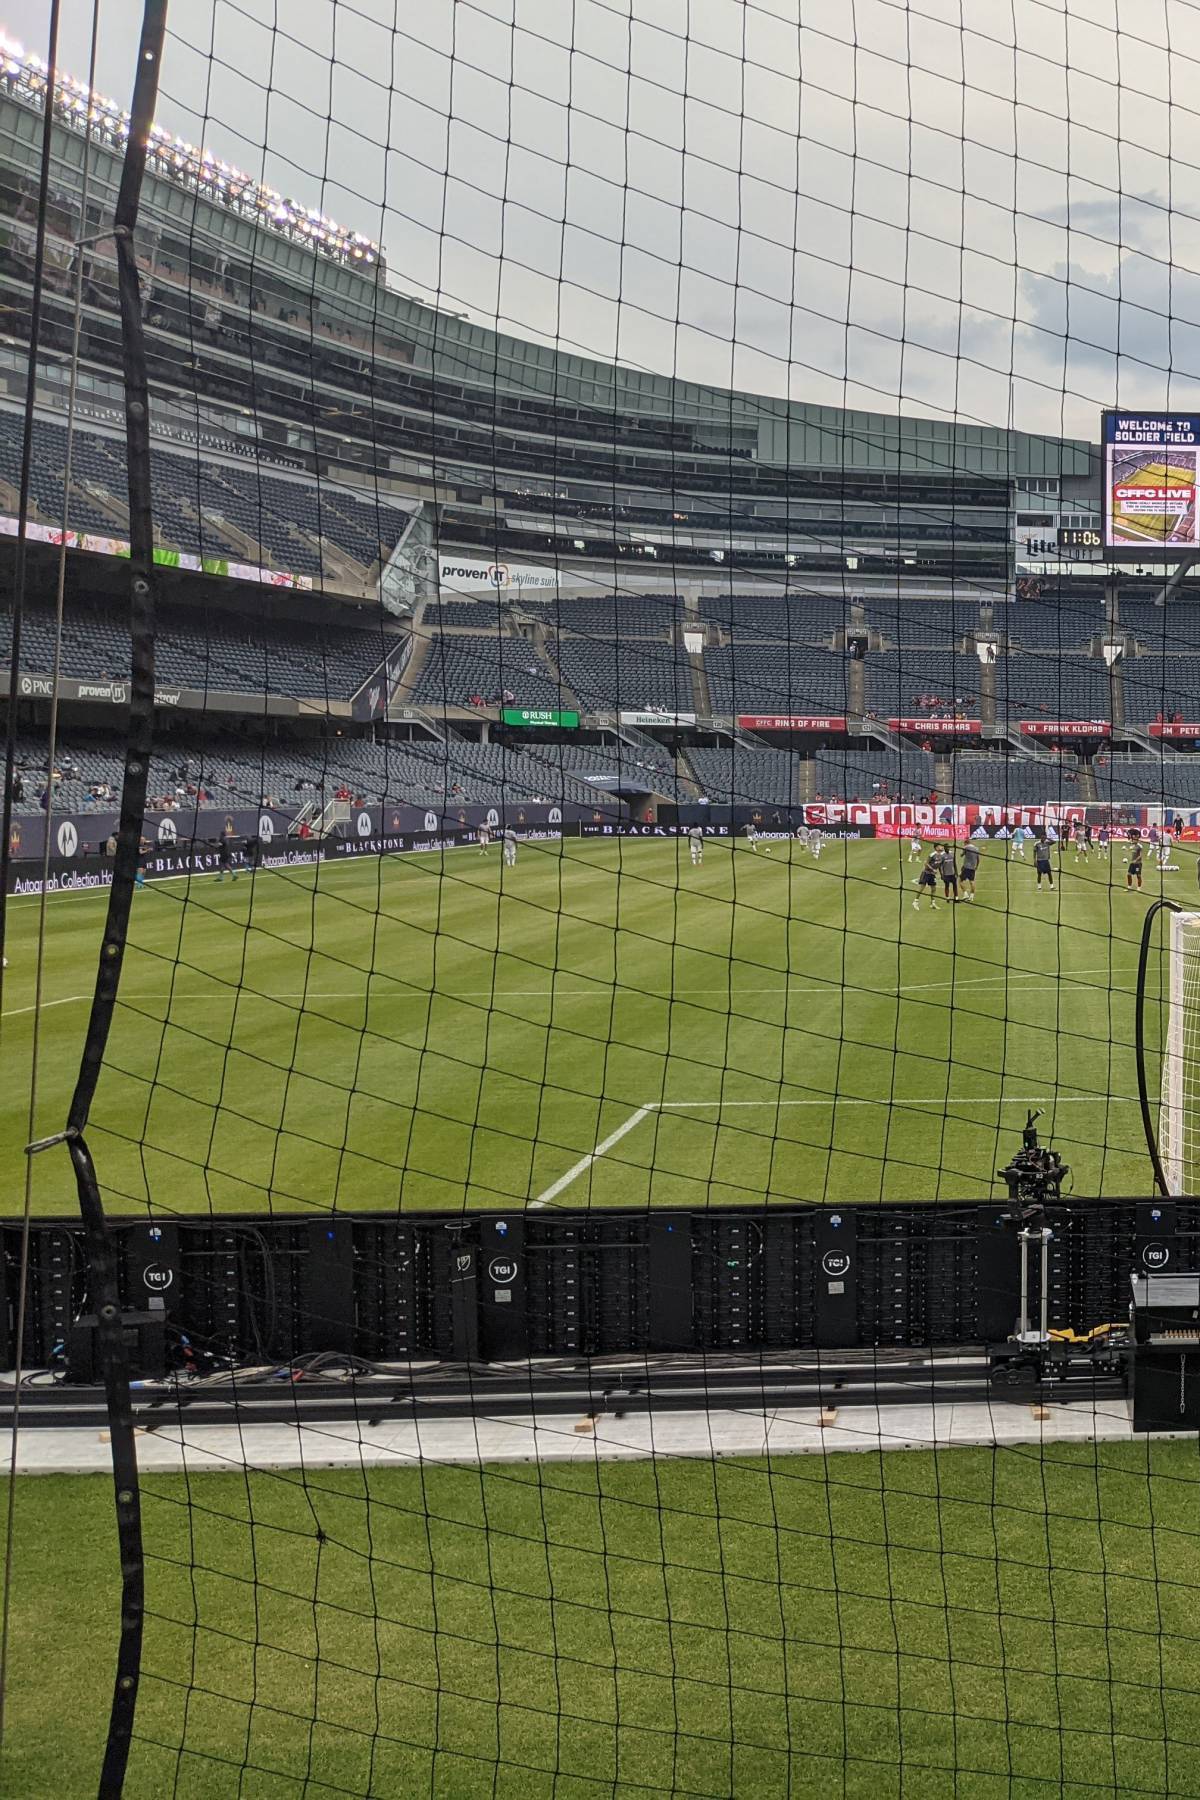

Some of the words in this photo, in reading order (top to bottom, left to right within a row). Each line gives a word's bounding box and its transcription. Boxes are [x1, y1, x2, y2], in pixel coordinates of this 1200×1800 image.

[1118, 420, 1173, 432] WELCOME
[1176, 421, 1191, 432] TO
[1115, 431, 1160, 443] SOLDIER
[1163, 432, 1195, 443] FIELD
[1158, 489, 1191, 499] LIVE
[1063, 531, 1101, 545] 11:06
[442, 566, 488, 580] proven
[494, 570, 505, 582] IT
[511, 572, 539, 586] skyline
[33, 682, 53, 694] PNC
[78, 685, 111, 698] proven
[530, 711, 552, 719] RUSH
[637, 716, 671, 724] Heineken
[775, 719, 794, 728] RING
[798, 720, 808, 728] OF
[812, 721, 830, 729] FIRE
[915, 722, 940, 730] CHRIS
[943, 723, 971, 731] ARMAS
[1043, 725, 1070, 733] FRANK
[1073, 725, 1103, 733] KLOPAS
[603, 826, 729, 835] BLACKSTNE
[840, 830, 860, 838] Hotel
[346, 838, 404, 853] BLACKSTONE
[61, 869, 99, 889] Collection
[1149, 1252, 1163, 1260] TGI
[494, 1266, 511, 1274] TGI
[149, 1272, 165, 1281] TGI
